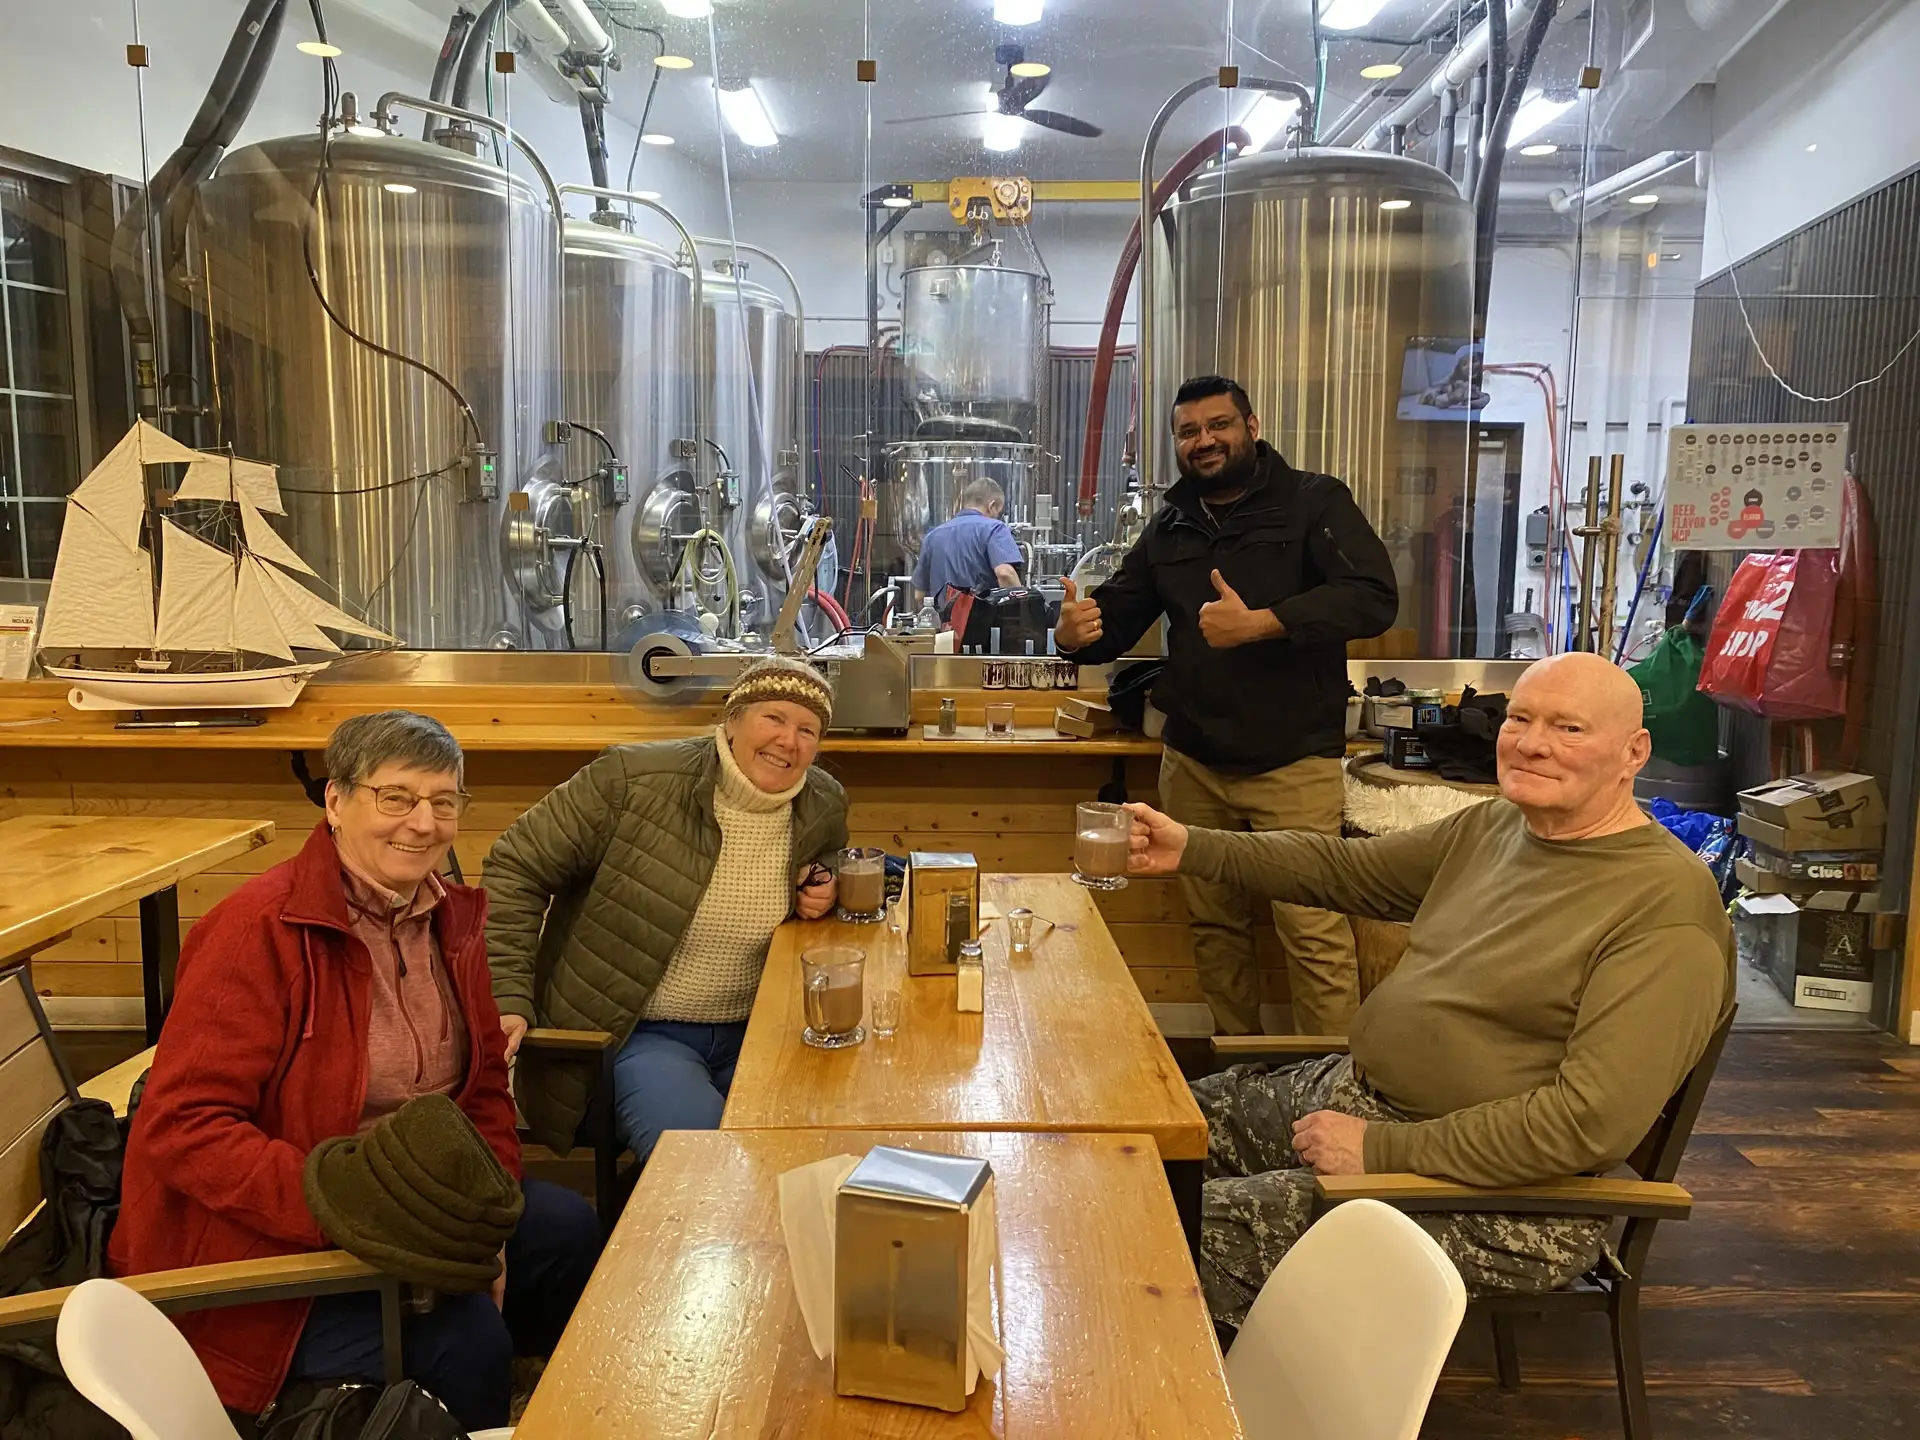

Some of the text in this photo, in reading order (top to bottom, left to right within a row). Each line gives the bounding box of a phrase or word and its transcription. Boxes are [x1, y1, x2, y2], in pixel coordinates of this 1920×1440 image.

[1673, 504, 1696, 516] BEER
[1672, 516, 1706, 529] FLAVOR
[1807, 865, 1844, 879] Clue
[1832, 934, 1856, 957] A
